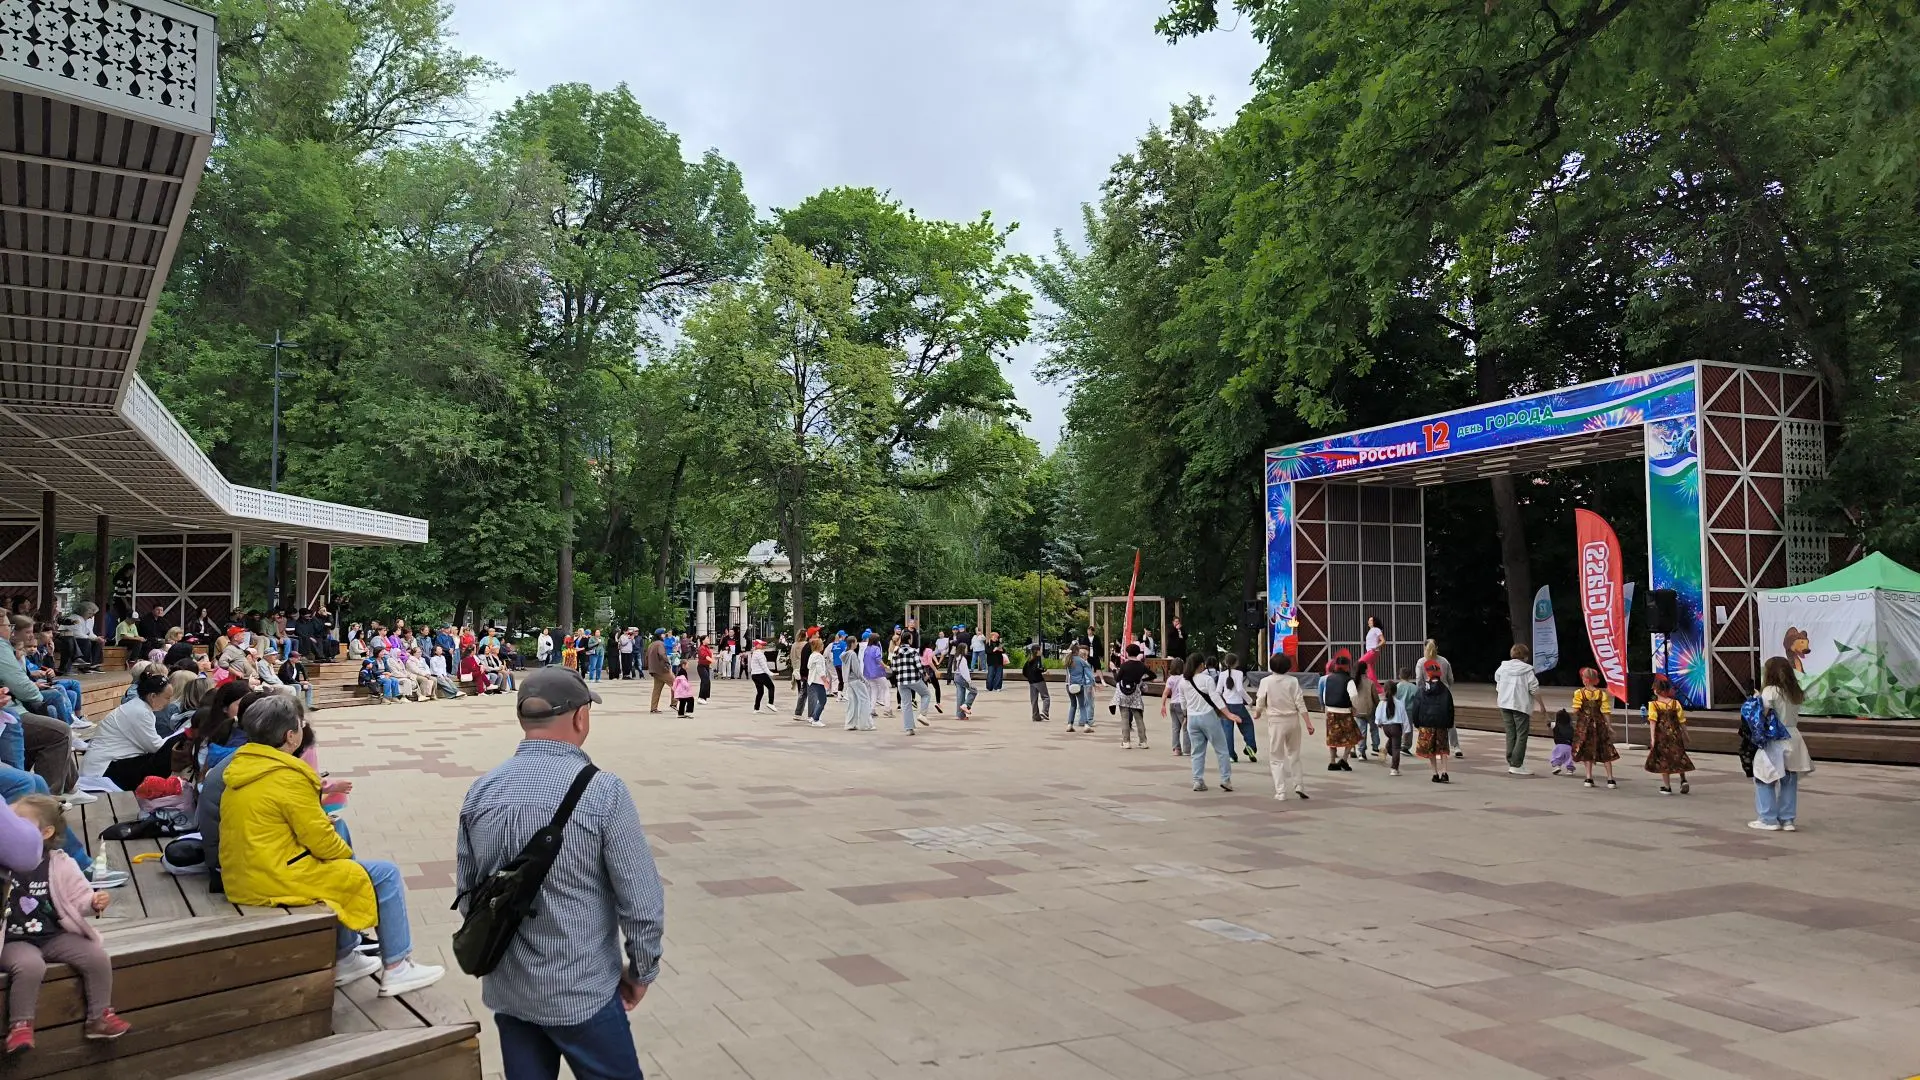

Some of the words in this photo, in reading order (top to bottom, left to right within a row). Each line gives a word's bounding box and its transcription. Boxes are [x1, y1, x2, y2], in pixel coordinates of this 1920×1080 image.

[1422, 421, 1449, 452] 12
[1457, 423, 1483, 438] ДЕНЬ
[1486, 406, 1554, 431] ГОРОДА
[1336, 457, 1357, 469] ДЕНЬ
[1358, 441, 1417, 464] РОССИИ
